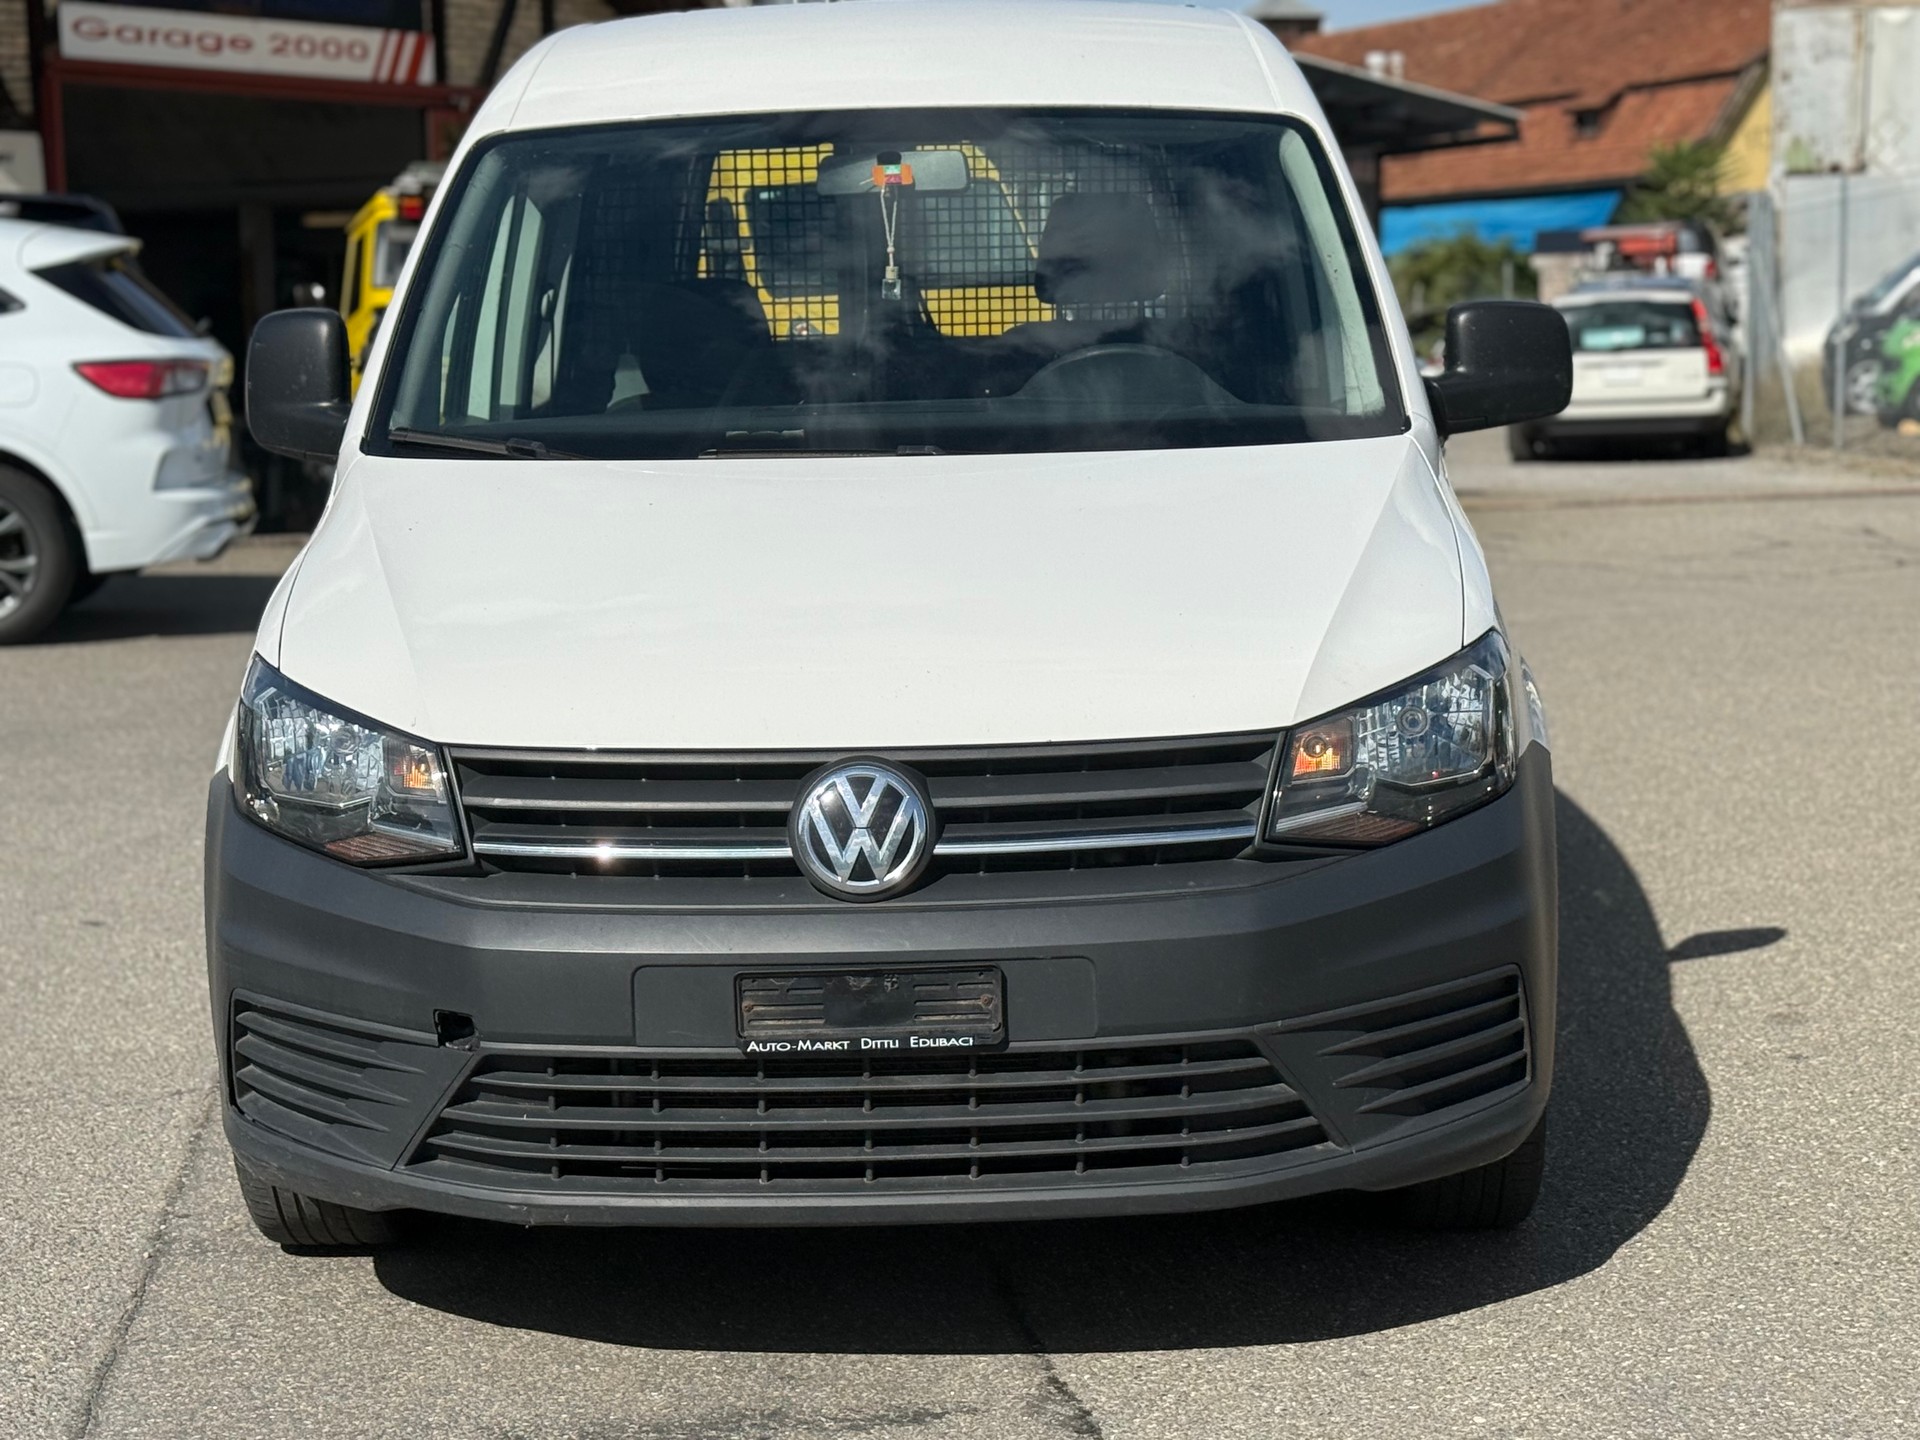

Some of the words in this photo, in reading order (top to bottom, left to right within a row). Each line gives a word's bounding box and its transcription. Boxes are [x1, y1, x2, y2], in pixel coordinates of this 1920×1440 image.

[71, 15, 255, 56] Garage
[266, 33, 370, 63] 2000
[798, 766, 926, 892] VW
